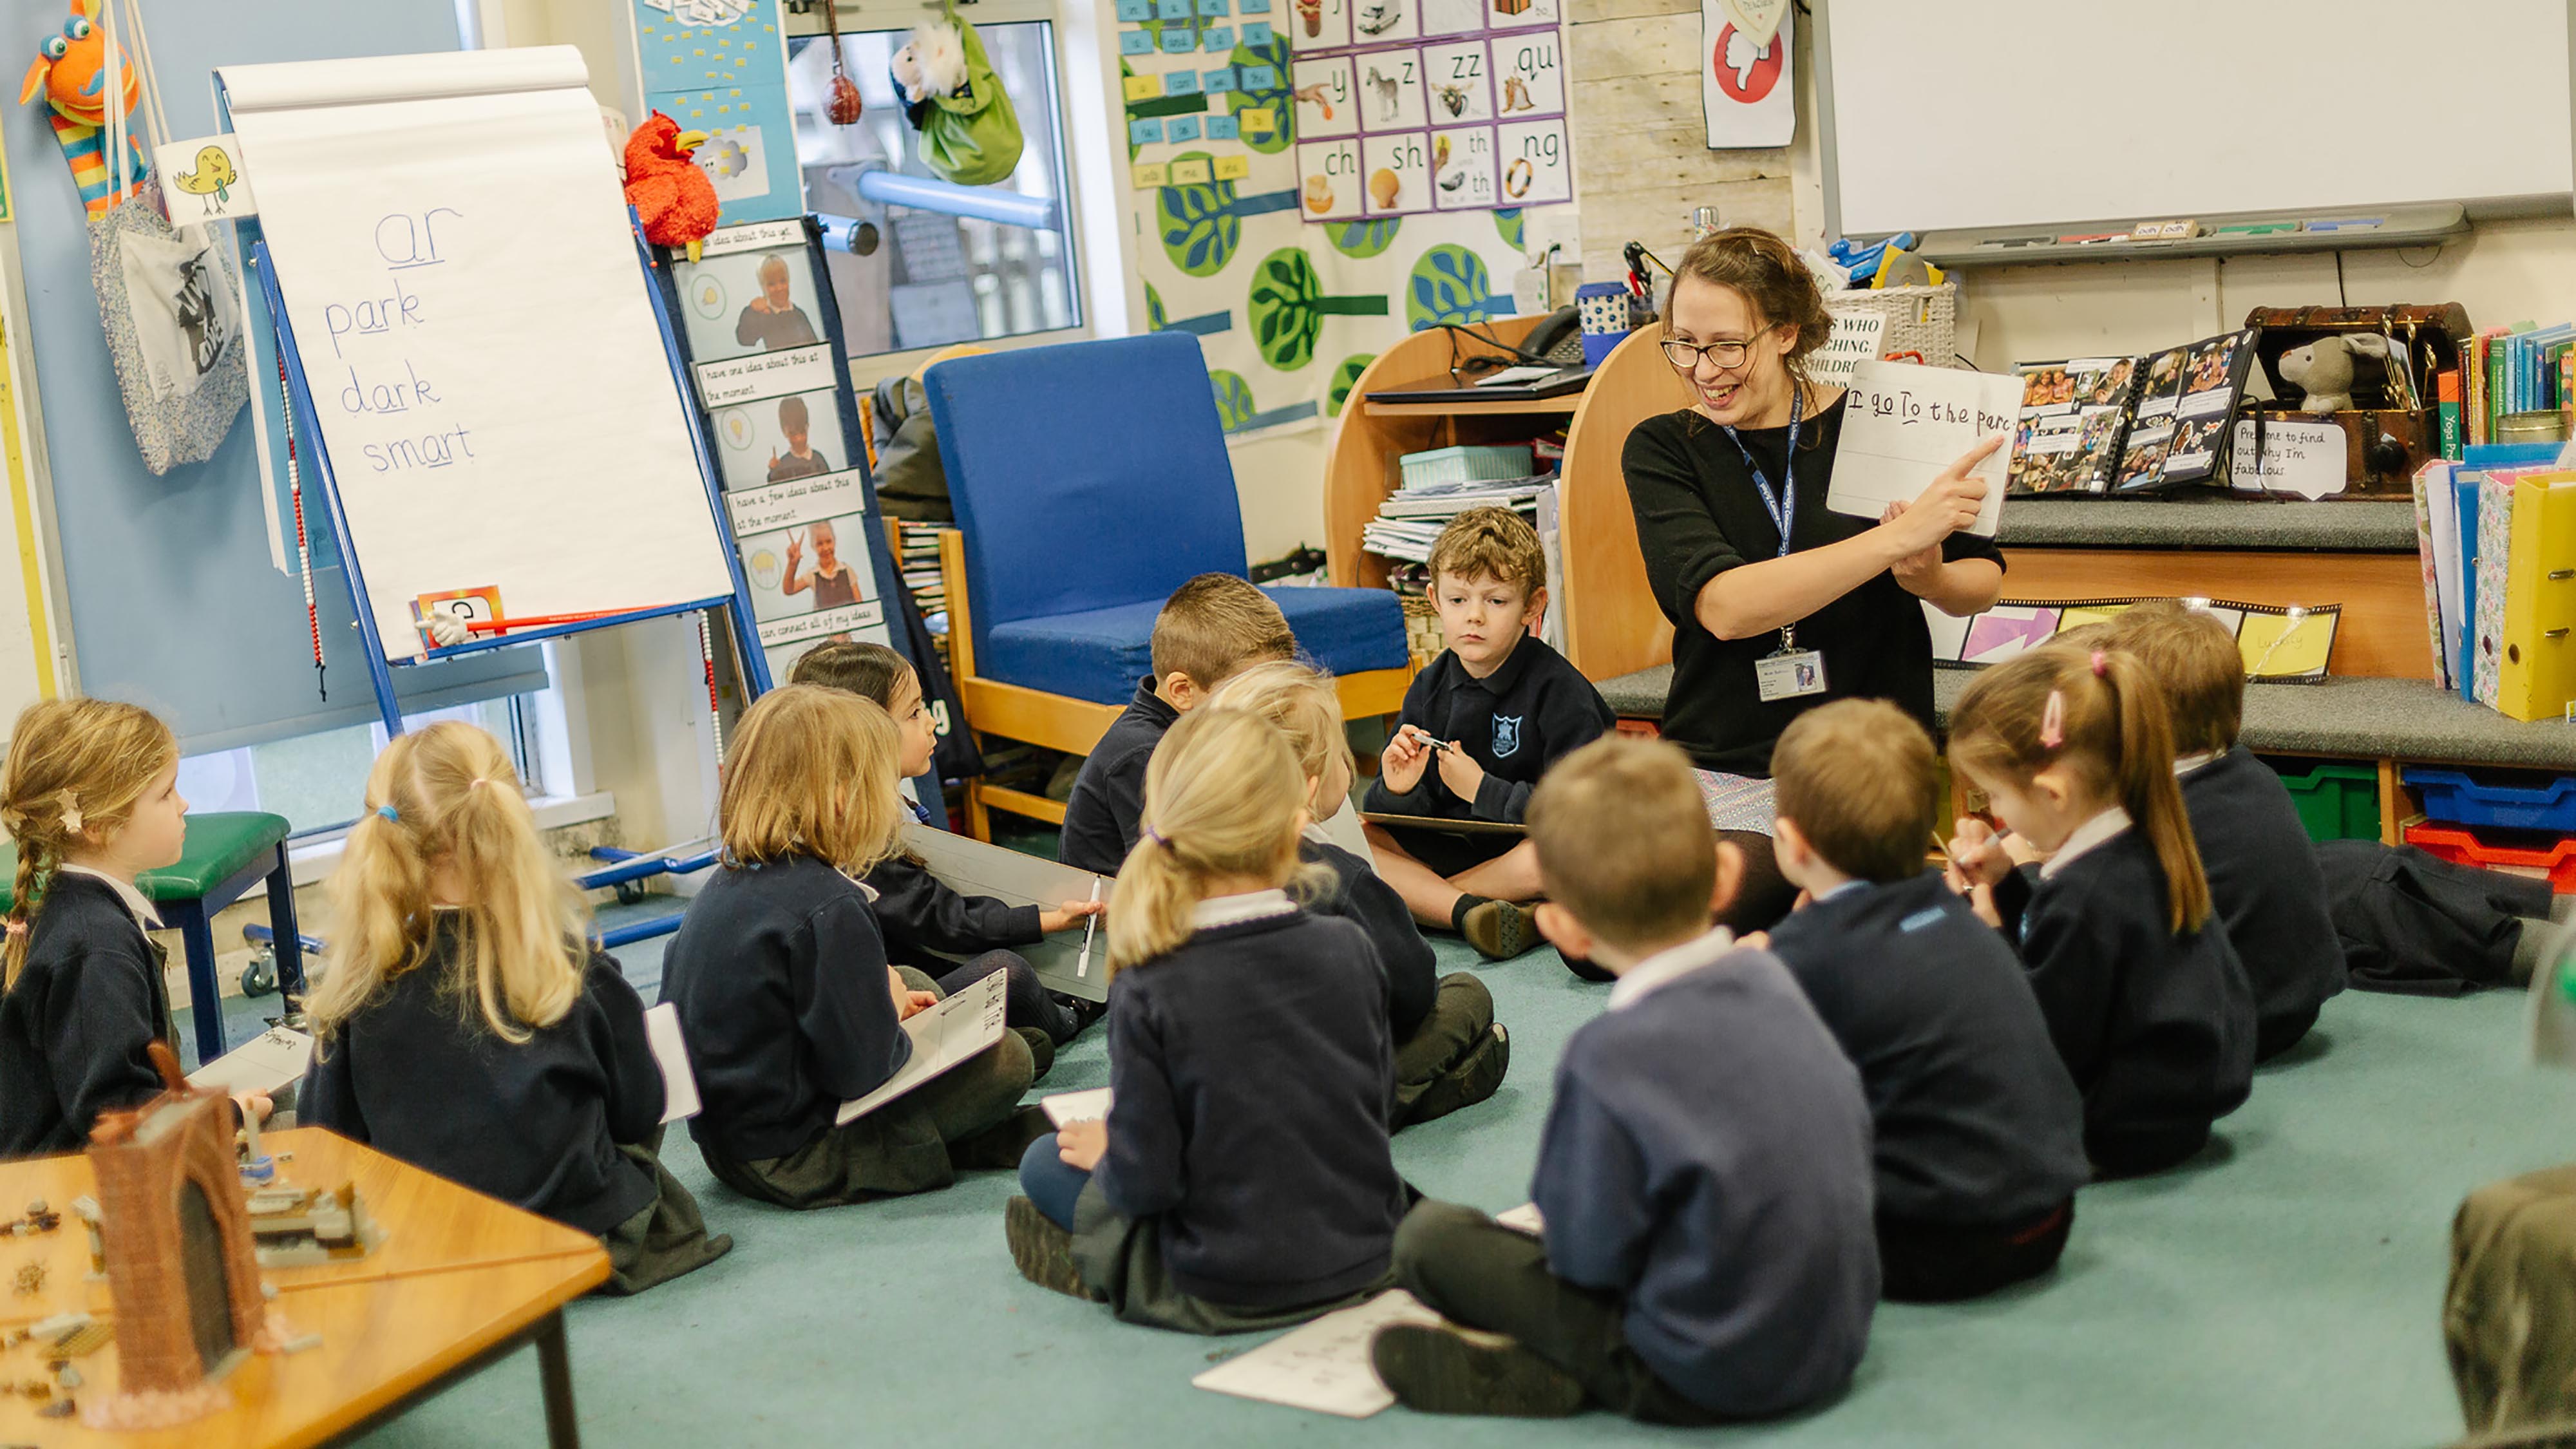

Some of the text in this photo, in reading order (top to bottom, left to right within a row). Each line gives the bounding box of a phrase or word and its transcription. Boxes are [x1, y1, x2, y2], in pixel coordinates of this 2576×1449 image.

[1402, 62, 1416, 84] z
[1452, 54, 1481, 79] zz
[1518, 44, 1554, 82] qu
[1332, 69, 1346, 102] y
[1392, 136, 1424, 169] sh
[1470, 131, 1488, 153] th
[1524, 133, 1558, 167] ng
[1325, 144, 1356, 175] ch
[1472, 169, 1490, 193] th
[375, 207, 464, 265] ar
[712, 234, 731, 246] idea
[734, 232, 757, 243] about
[759, 228, 777, 239] this
[325, 278, 425, 359] park
[1843, 318, 1879, 332] WHO
[706, 368, 726, 379] have
[728, 368, 743, 376] one
[745, 361, 763, 374] idea
[766, 357, 789, 370] about
[790, 353, 806, 365] this
[810, 352, 819, 363] at
[342, 359, 441, 413] dark
[706, 390, 721, 401] the
[1848, 390, 1863, 409] I
[1871, 393, 1893, 417] go
[1930, 401, 1969, 423] the
[2240, 427, 2325, 444] Pre me to find
[2445, 414, 2456, 440] Yoga
[363, 423, 474, 471] smart
[2237, 447, 2256, 457] out
[2286, 447, 2306, 459] I'm
[736, 496, 757, 507] have
[768, 489, 784, 506] few
[787, 485, 807, 498] ideas
[810, 480, 832, 493] about
[834, 476, 850, 488] this
[736, 519, 746, 530] at
[748, 515, 762, 527] the
[761, 629, 776, 638] can
[778, 621, 807, 635] connect
[810, 617, 820, 629] all
[823, 613, 833, 630] of
[836, 614, 849, 627] my
